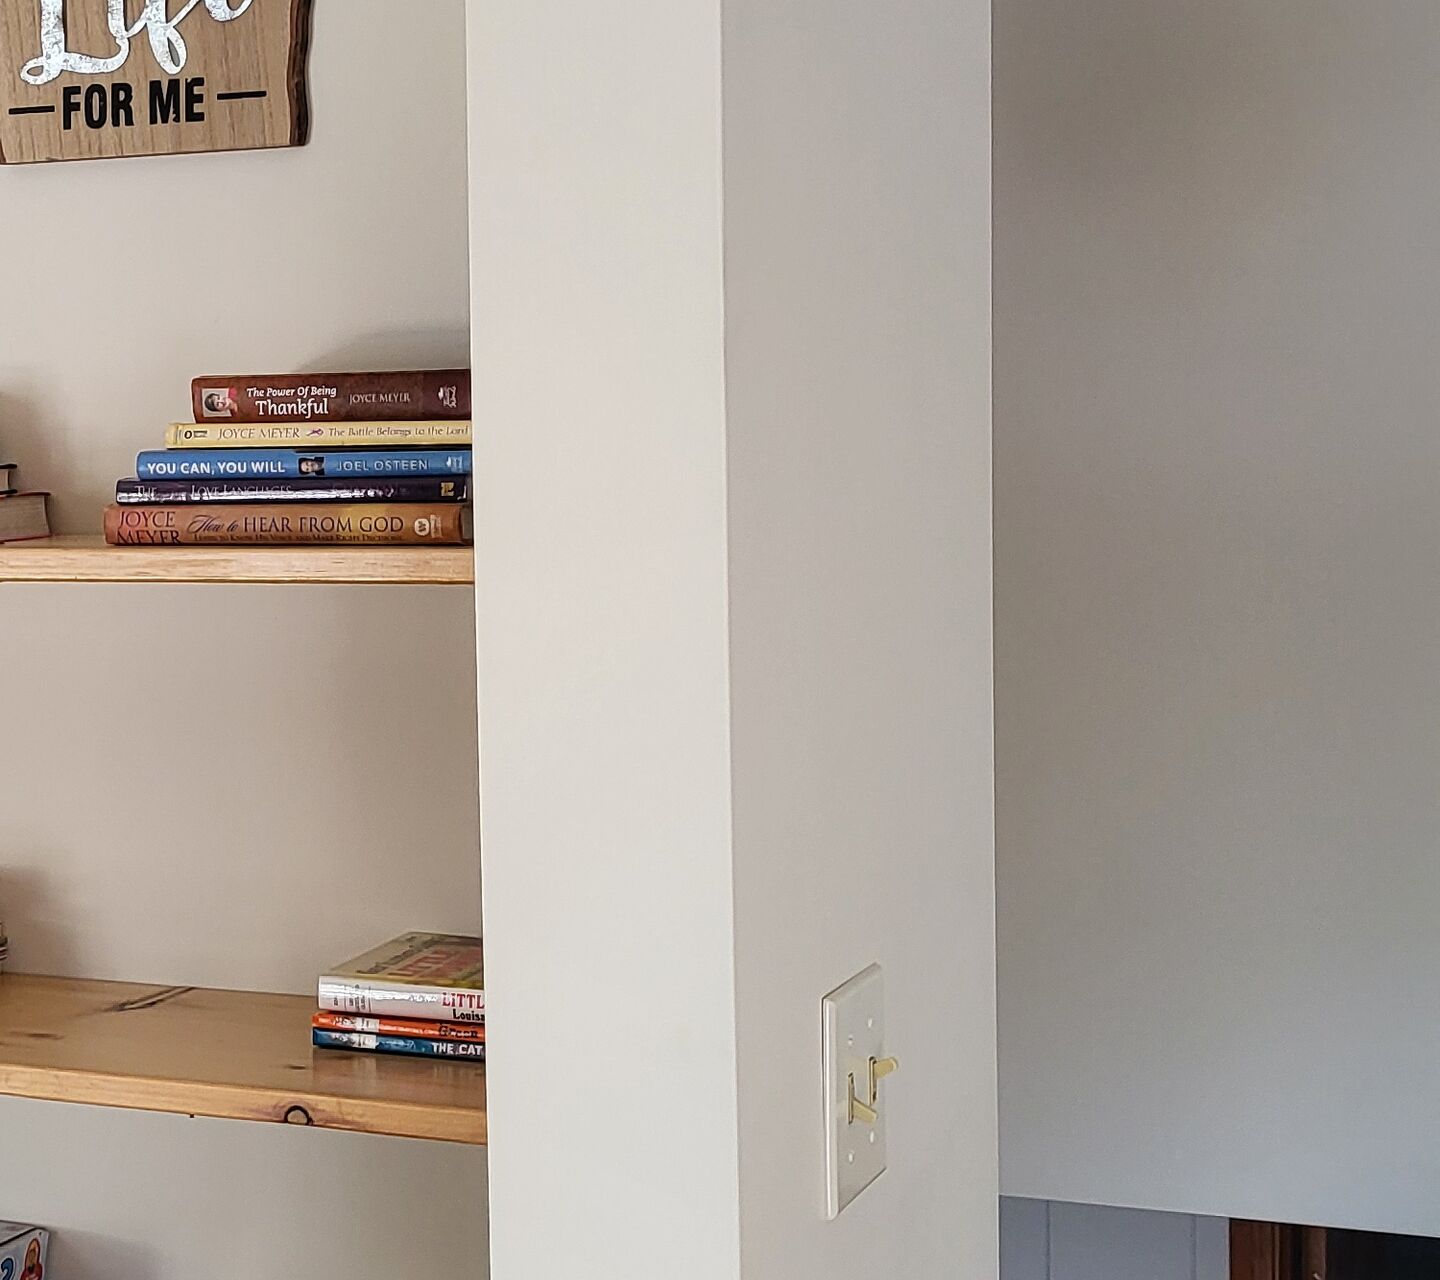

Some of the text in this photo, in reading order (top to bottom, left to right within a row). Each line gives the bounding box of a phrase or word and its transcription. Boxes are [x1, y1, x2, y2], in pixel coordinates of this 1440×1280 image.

[62, 77, 205, 130] FOR ME
[247, 386, 337, 398] The Power Of Being
[349, 392, 411, 405] JOYCE MEYER
[255, 398, 329, 419] Thankful
[217, 428, 255, 440] JOYCE
[259, 427, 300, 439] MEYER
[328, 427, 345, 437] The
[348, 426, 375, 437] Battle
[376, 426, 412, 439] Belongs
[414, 427, 425, 437] to
[427, 425, 445, 436] the
[447, 425, 469, 436] Lord
[147, 460, 286, 477] YOU CAN, YOU WILL
[337, 458, 429, 472] JOEL OSTEEN
[118, 511, 176, 528] JOYCE
[187, 513, 404, 533] How to HEAR FROM GOD
[116, 529, 181, 544] MEYER
[431, 1042, 483, 1056] THE CAT
